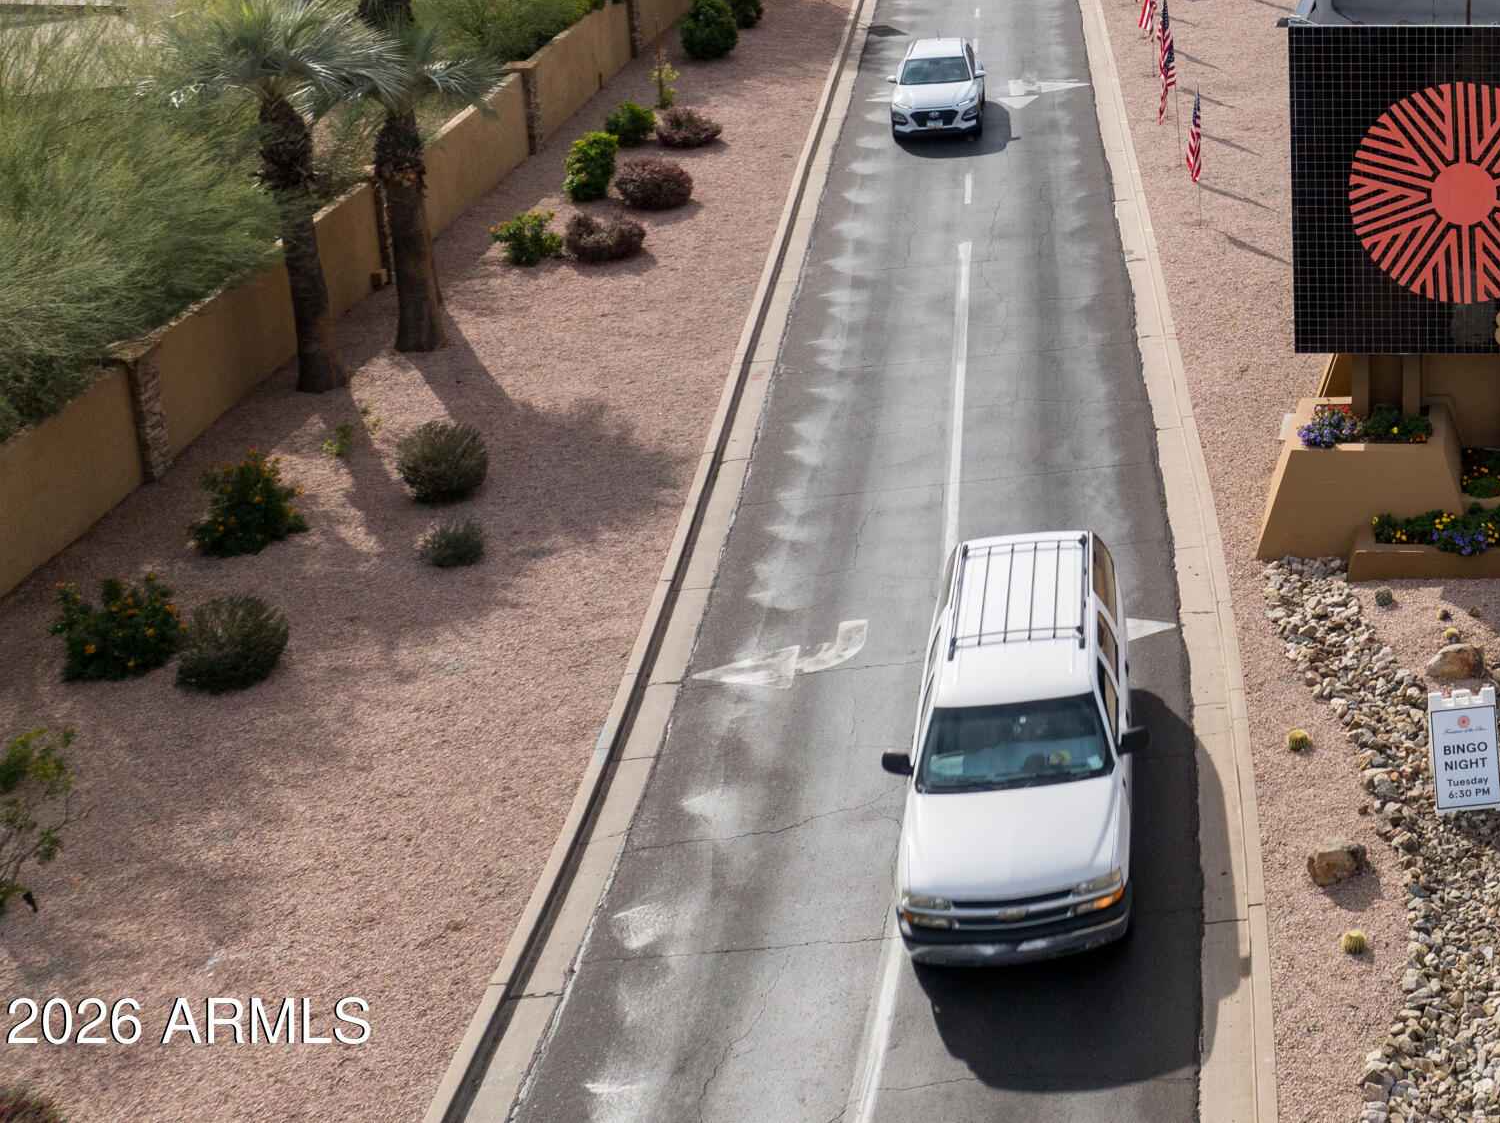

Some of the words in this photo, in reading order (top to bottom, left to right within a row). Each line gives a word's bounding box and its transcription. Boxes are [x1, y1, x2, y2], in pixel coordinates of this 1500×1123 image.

[1443, 741, 1488, 756] BINGO
[1443, 757, 1488, 771] NIGHT
[1447, 776, 1489, 787] Tuesday
[1448, 789, 1472, 799] 6:30
[1475, 787, 1491, 797] PM
